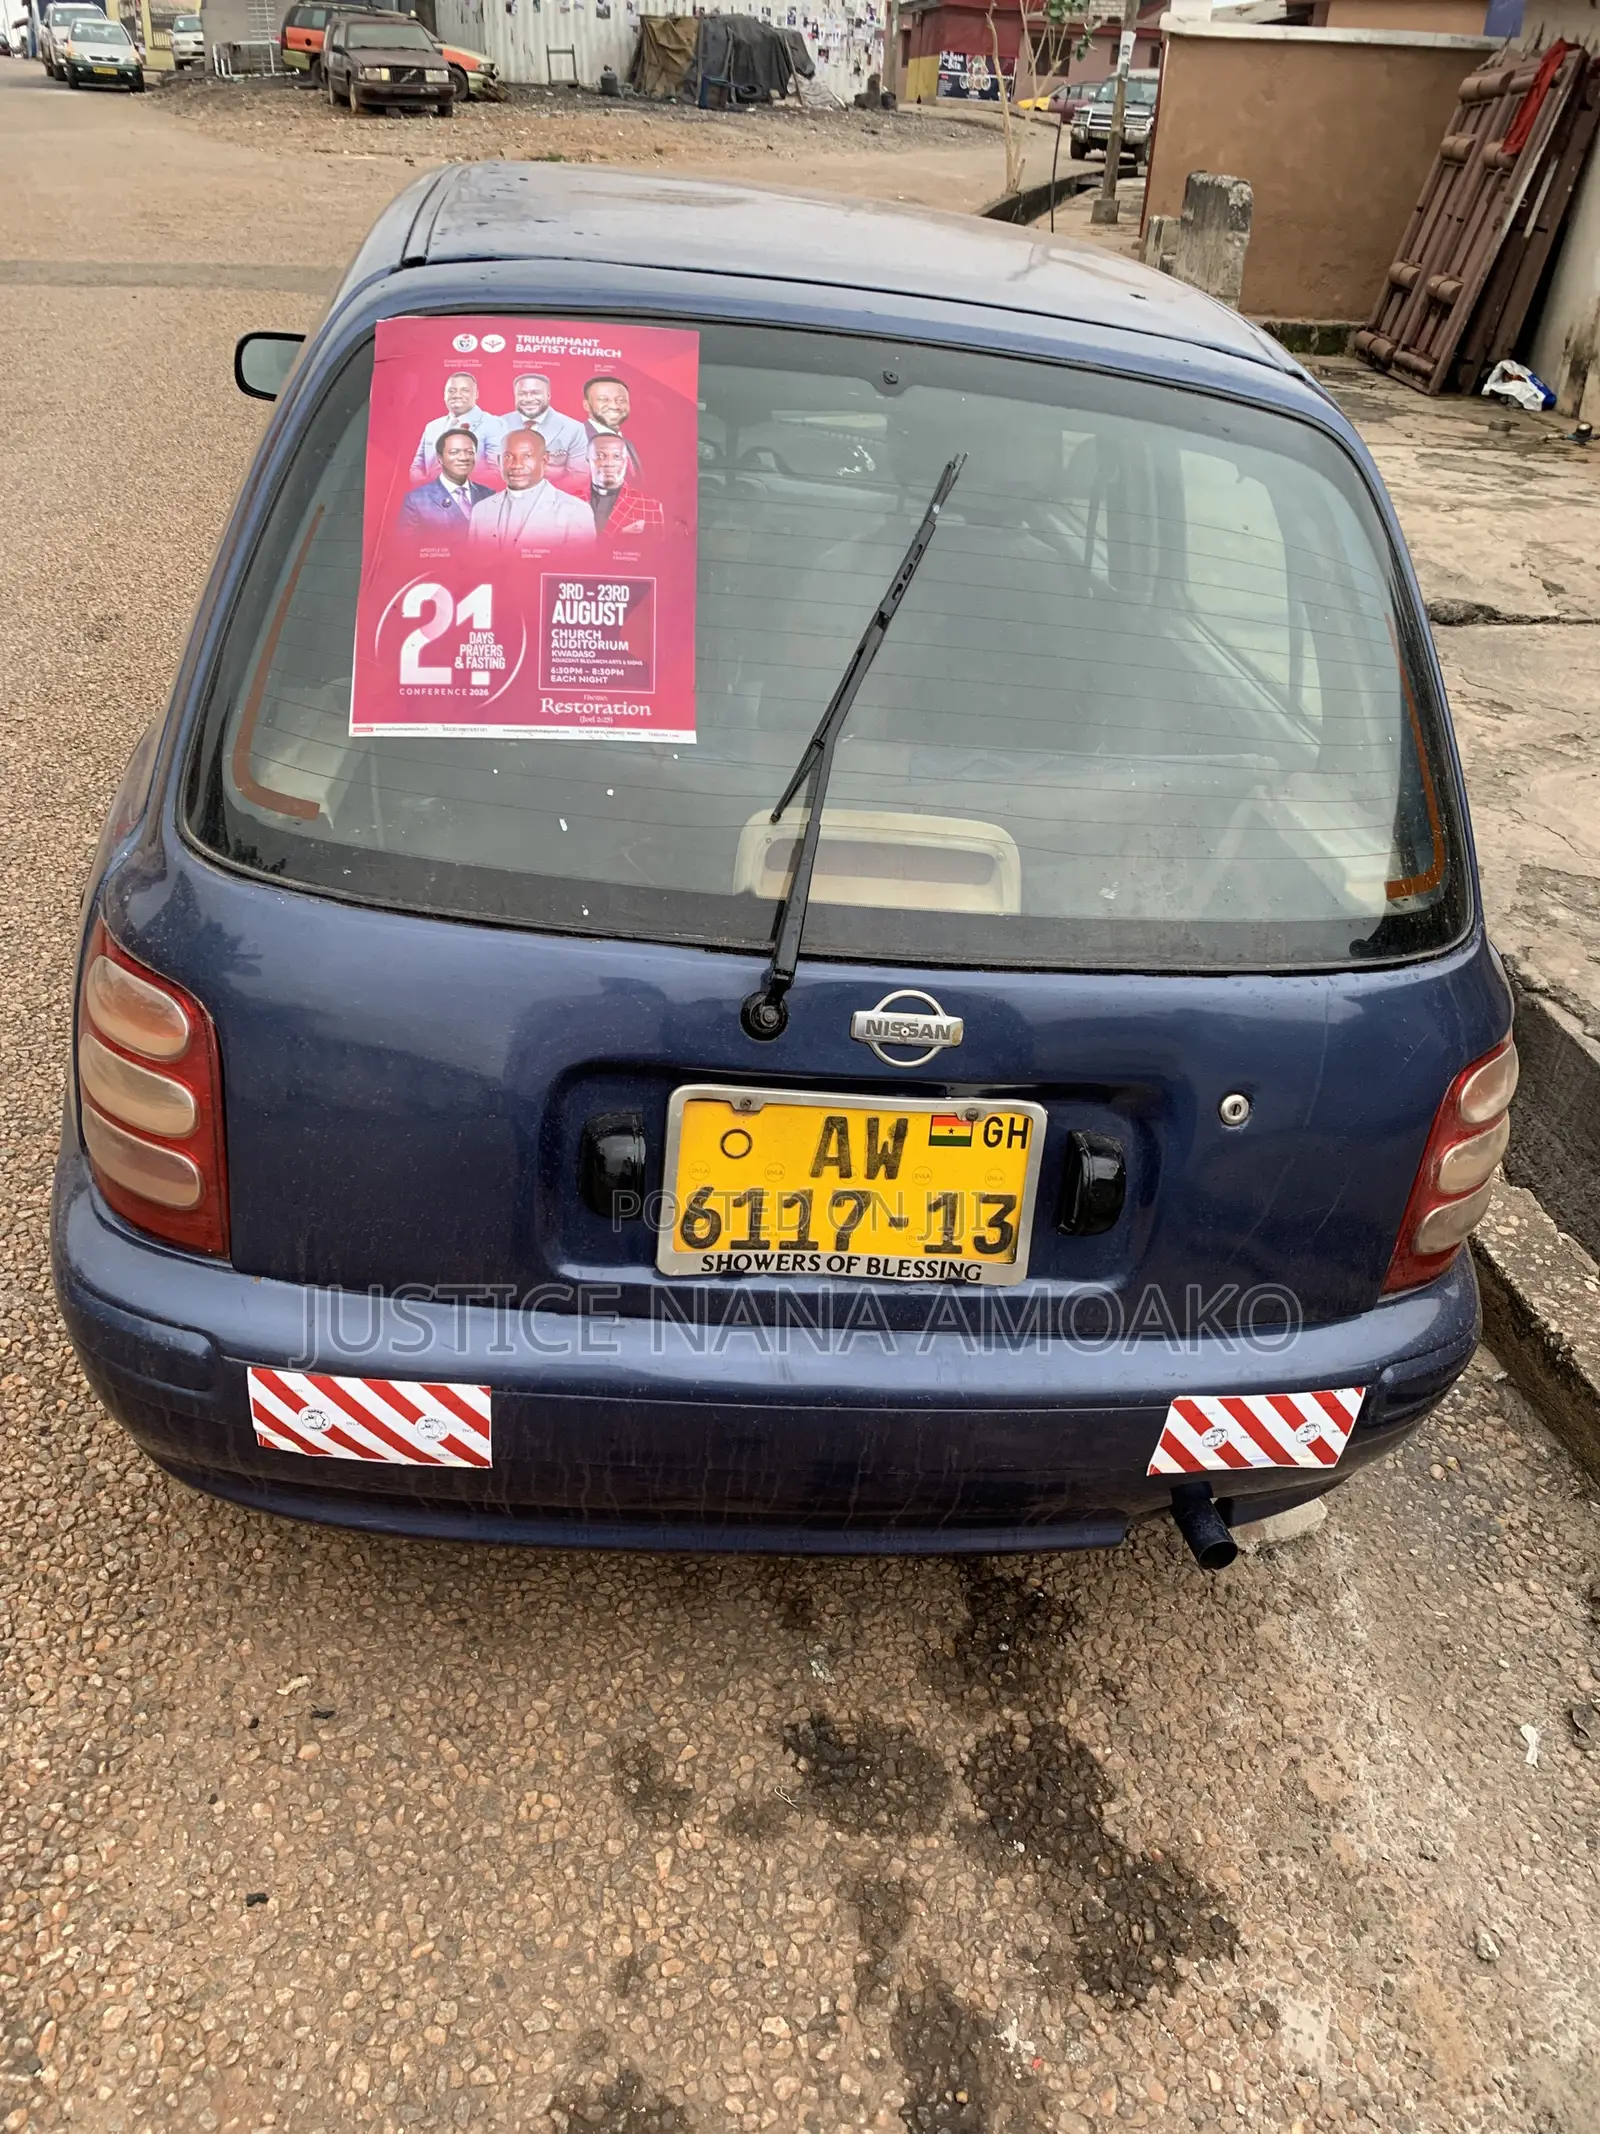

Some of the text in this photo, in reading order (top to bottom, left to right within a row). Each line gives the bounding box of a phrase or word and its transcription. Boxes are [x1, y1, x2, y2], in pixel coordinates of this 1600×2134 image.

[516, 334, 600, 348] TRIUMPHANT
[516, 344, 622, 358] BAPTIST CHURCH
[558, 583, 584, 600] 3RD
[597, 584, 630, 602] 23RD
[552, 600, 628, 626] AUGUST
[400, 582, 493, 686] 21
[469, 632, 495, 644] DAYS
[551, 629, 602, 640] CHURCH
[460, 645, 503, 657] PRAYERS
[551, 639, 629, 651] AUDITORIUM
[551, 650, 596, 658] KWADASO
[454, 657, 506, 669] & FASTING
[550, 666, 583, 674] 6:30PM
[592, 668, 624, 676] 8:30PM
[578, 676, 608, 684] NIGHT
[399, 687, 467, 696] CONFERENCE
[540, 697, 652, 716] Restoration
[865, 1019, 951, 1040] NISSAN
[983, 1116, 1029, 1150] GH
[810, 1115, 909, 1180] AW
[701, 1253, 982, 1281] SHOWERS OF BLESSING
